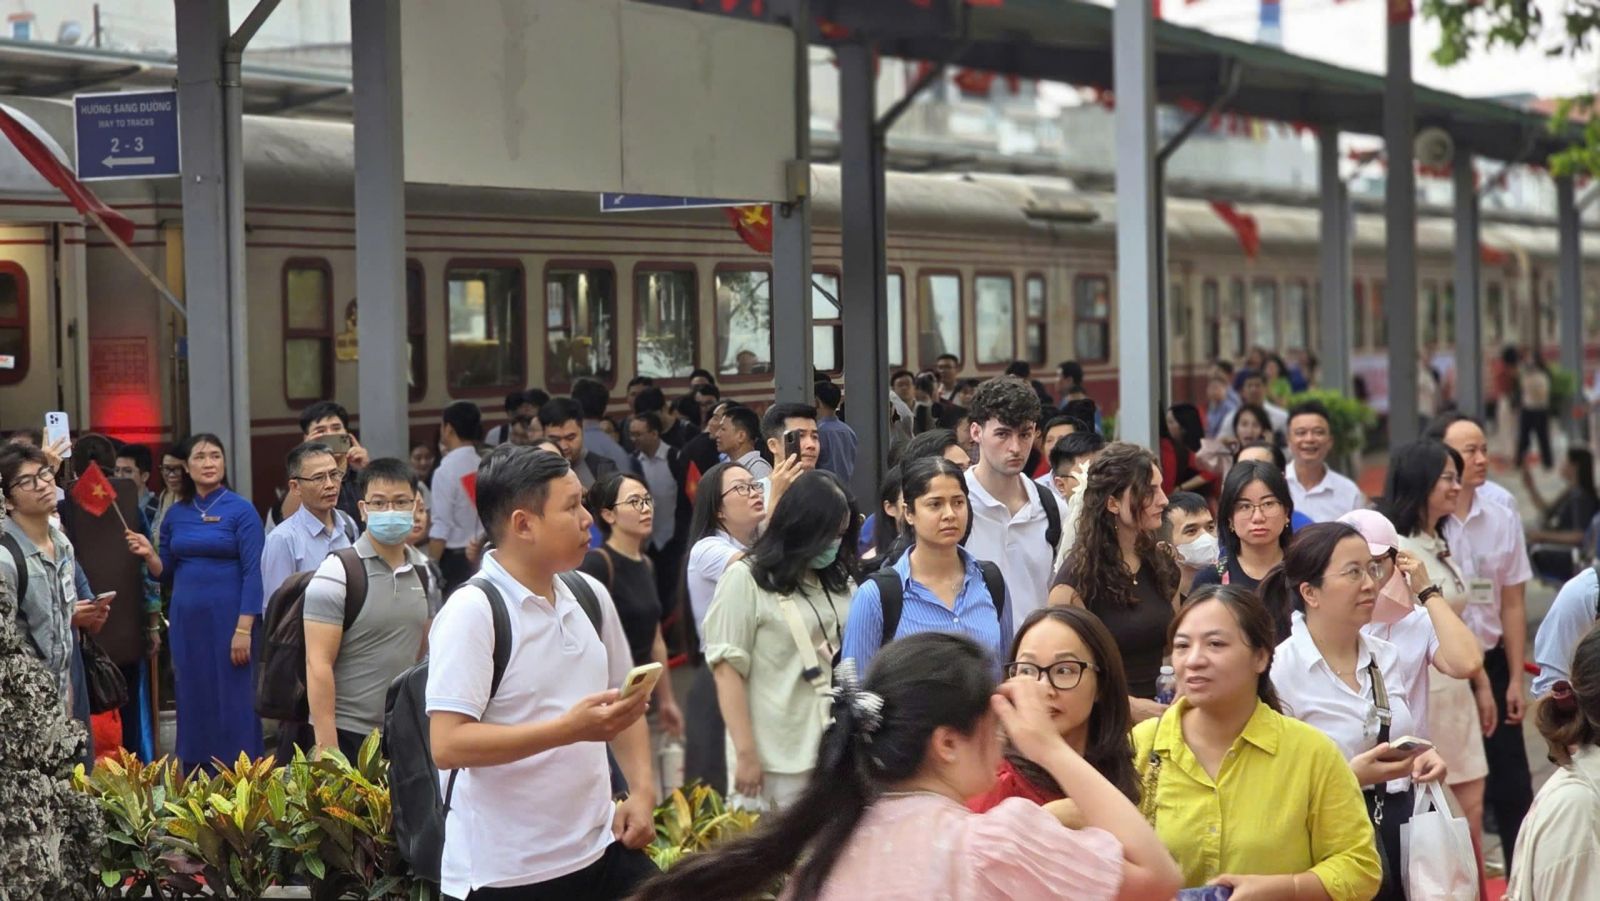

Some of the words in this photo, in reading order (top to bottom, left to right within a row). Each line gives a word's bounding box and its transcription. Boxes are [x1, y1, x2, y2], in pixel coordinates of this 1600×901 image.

[113, 103, 138, 113] SANG
[98, 119, 114, 128] WAY
[116, 119, 126, 128] TO
[127, 118, 154, 127] TRACKS
[111, 137, 120, 153] 2
[134, 136, 144, 152] 3
